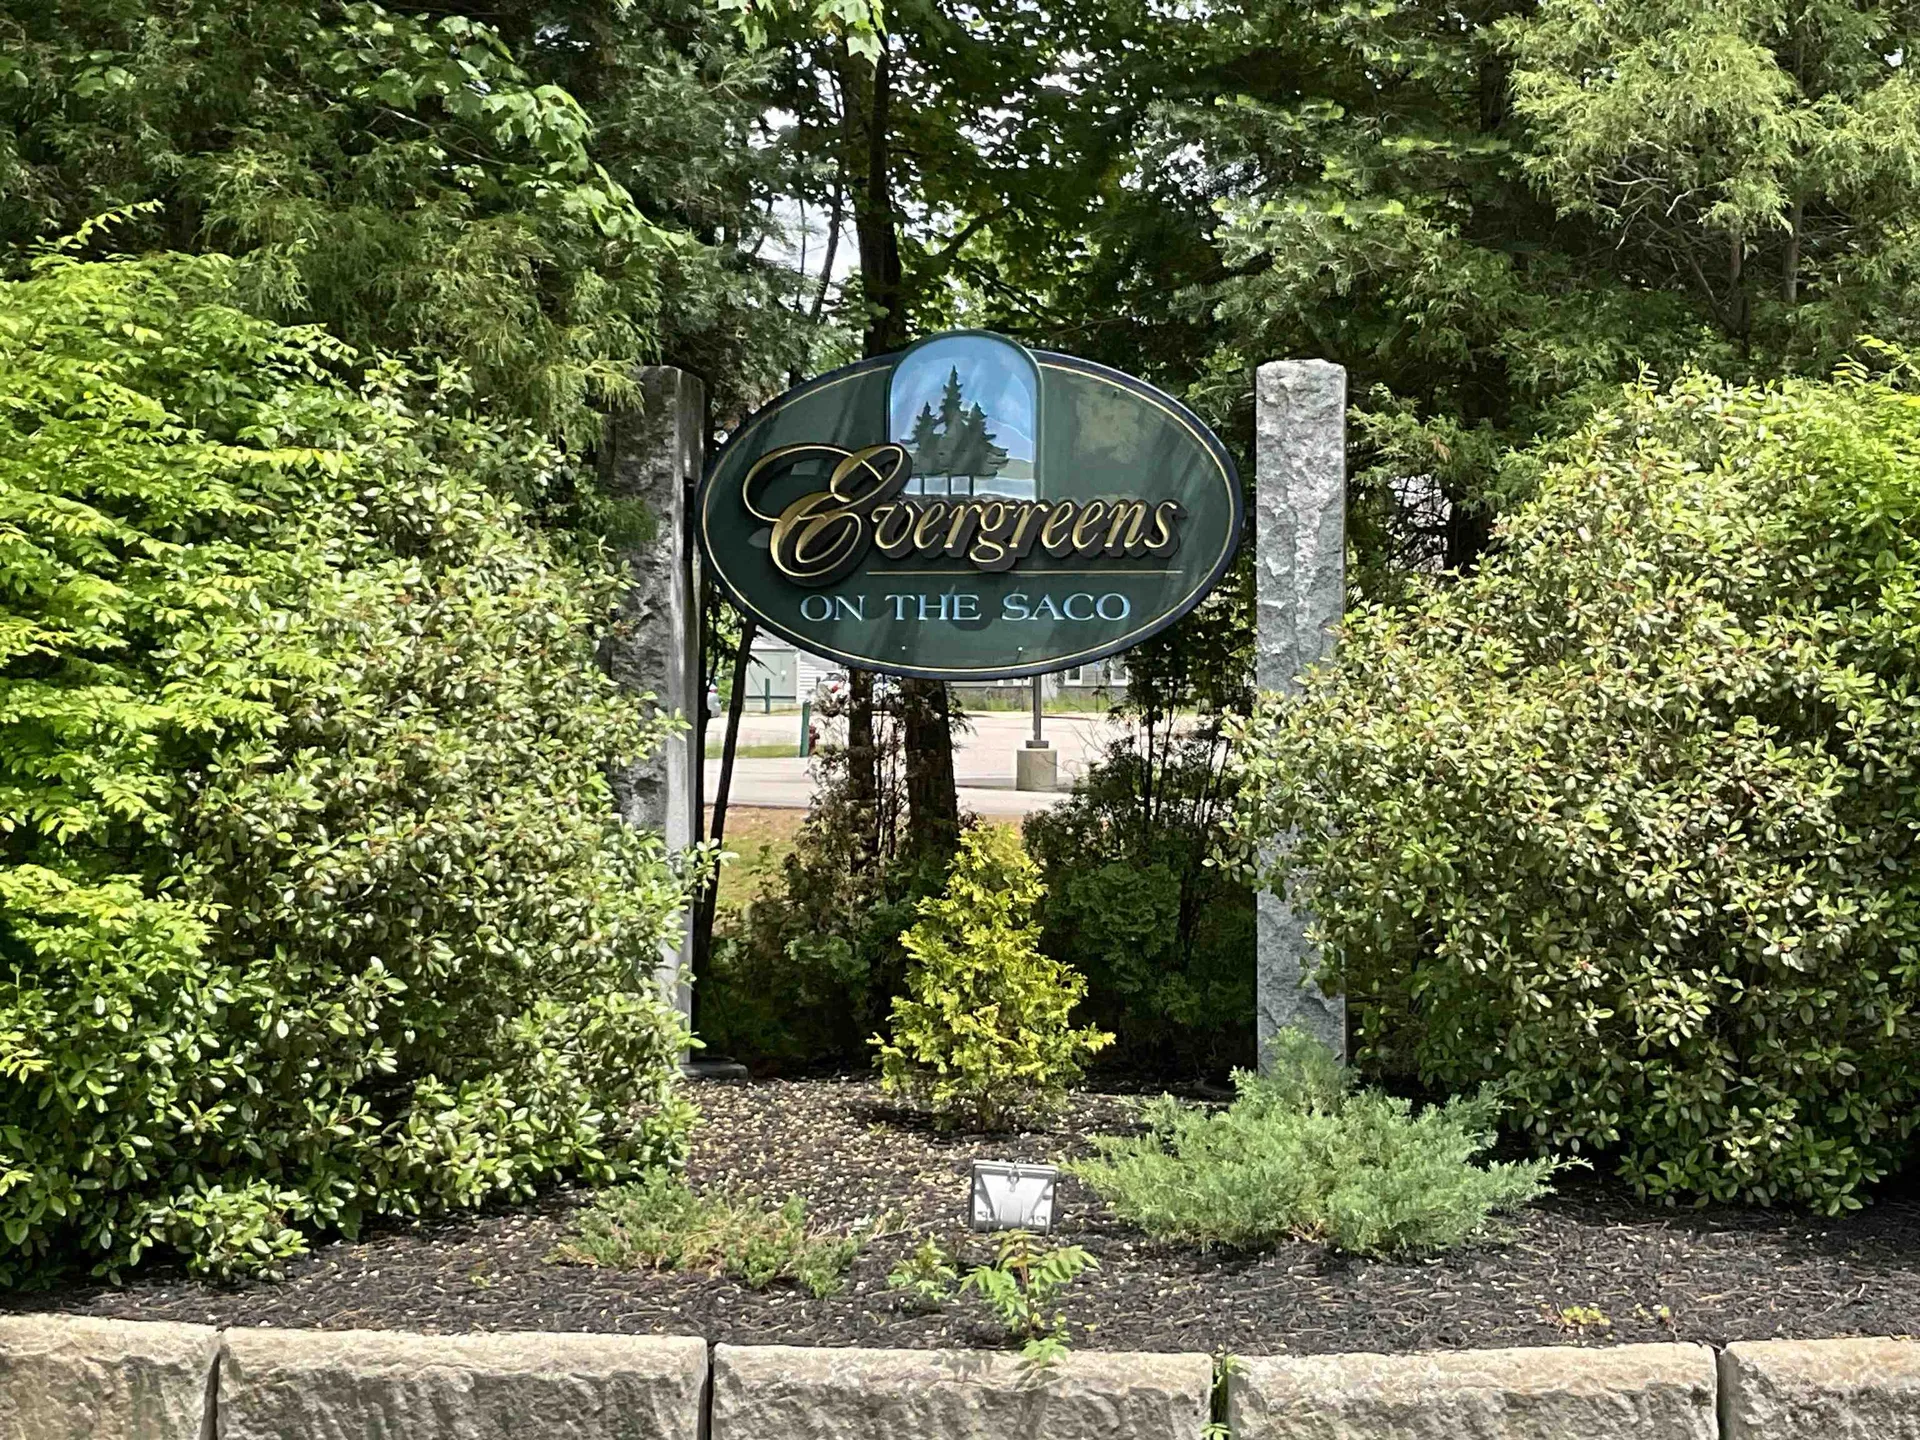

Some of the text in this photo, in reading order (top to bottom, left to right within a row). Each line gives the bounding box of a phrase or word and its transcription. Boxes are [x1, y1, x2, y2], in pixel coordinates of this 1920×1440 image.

[742, 443, 1182, 578] Evergreens
[799, 592, 1131, 622] ON THE SACO
